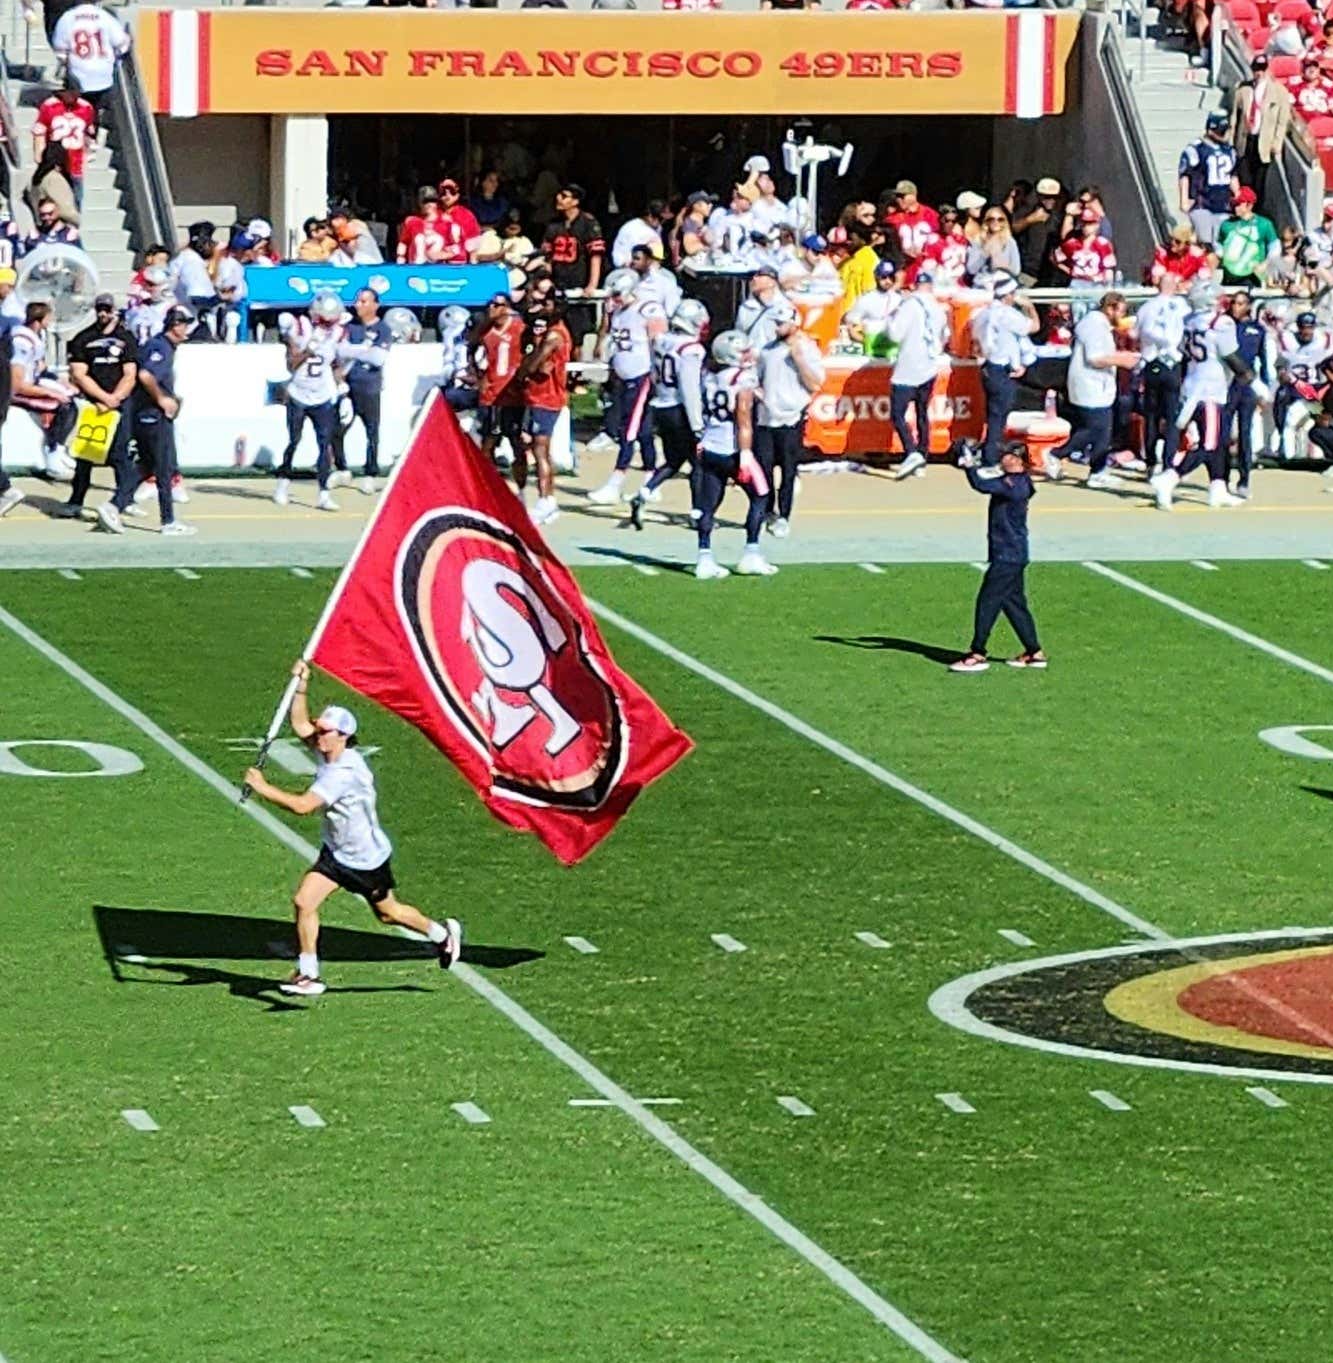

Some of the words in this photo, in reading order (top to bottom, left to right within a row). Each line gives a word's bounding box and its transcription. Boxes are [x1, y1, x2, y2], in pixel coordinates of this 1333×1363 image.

[74, 30, 107, 58] 81
[255, 49, 389, 77] SAN
[408, 49, 763, 78] FRANCISCO
[780, 50, 964, 79] 49ERS
[51, 114, 87, 150] 23
[1207, 155, 1234, 186] 12
[812, 394, 972, 422] GATODE
